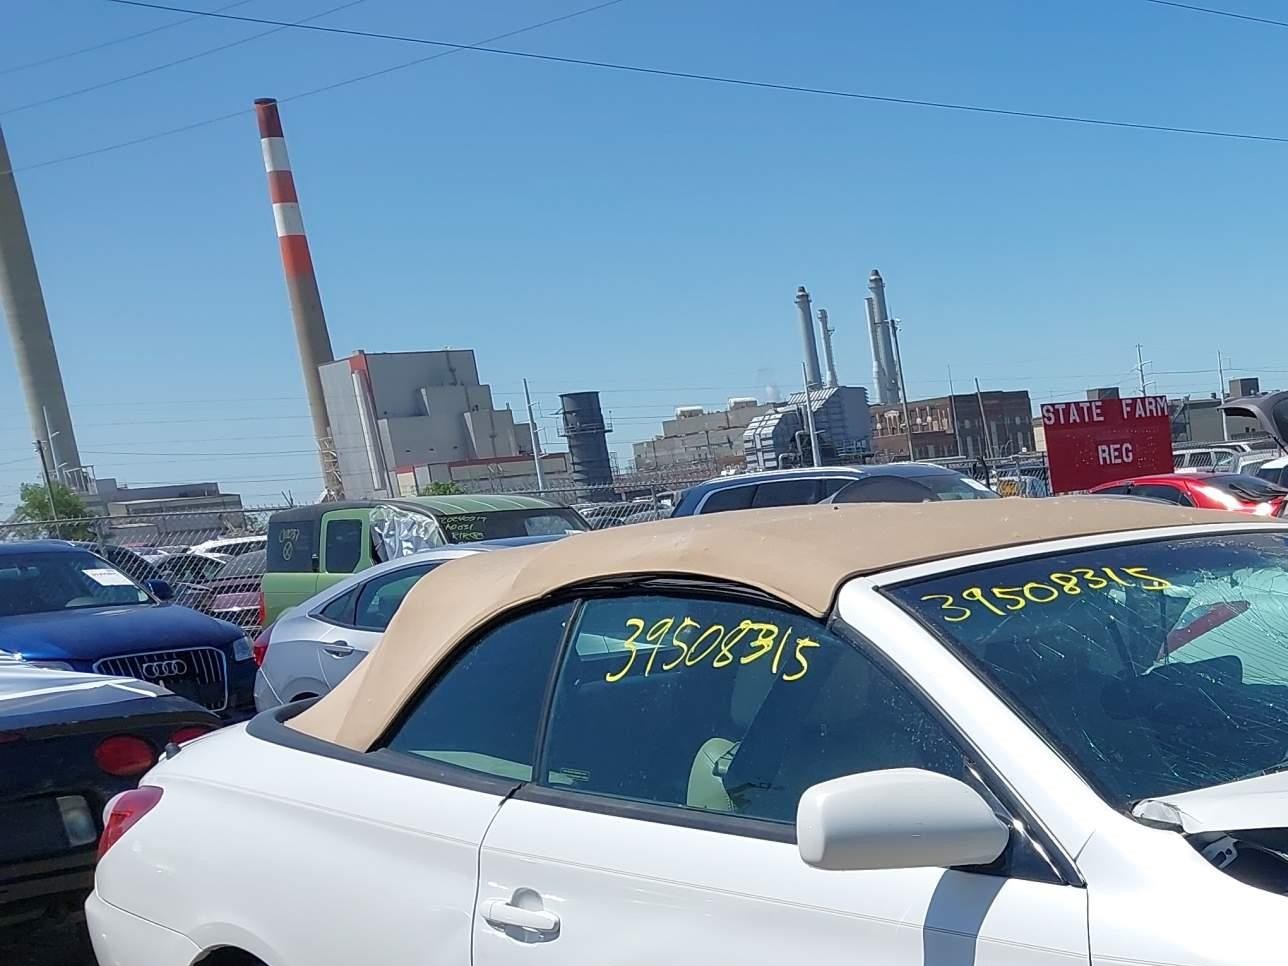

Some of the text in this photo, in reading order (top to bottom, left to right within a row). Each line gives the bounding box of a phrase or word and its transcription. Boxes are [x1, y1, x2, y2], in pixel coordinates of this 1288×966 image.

[1042, 396, 1169, 425] STATE FARM
[1097, 442, 1134, 466] REG
[920, 567, 1173, 622] 39508315
[605, 615, 821, 683] 39508315
